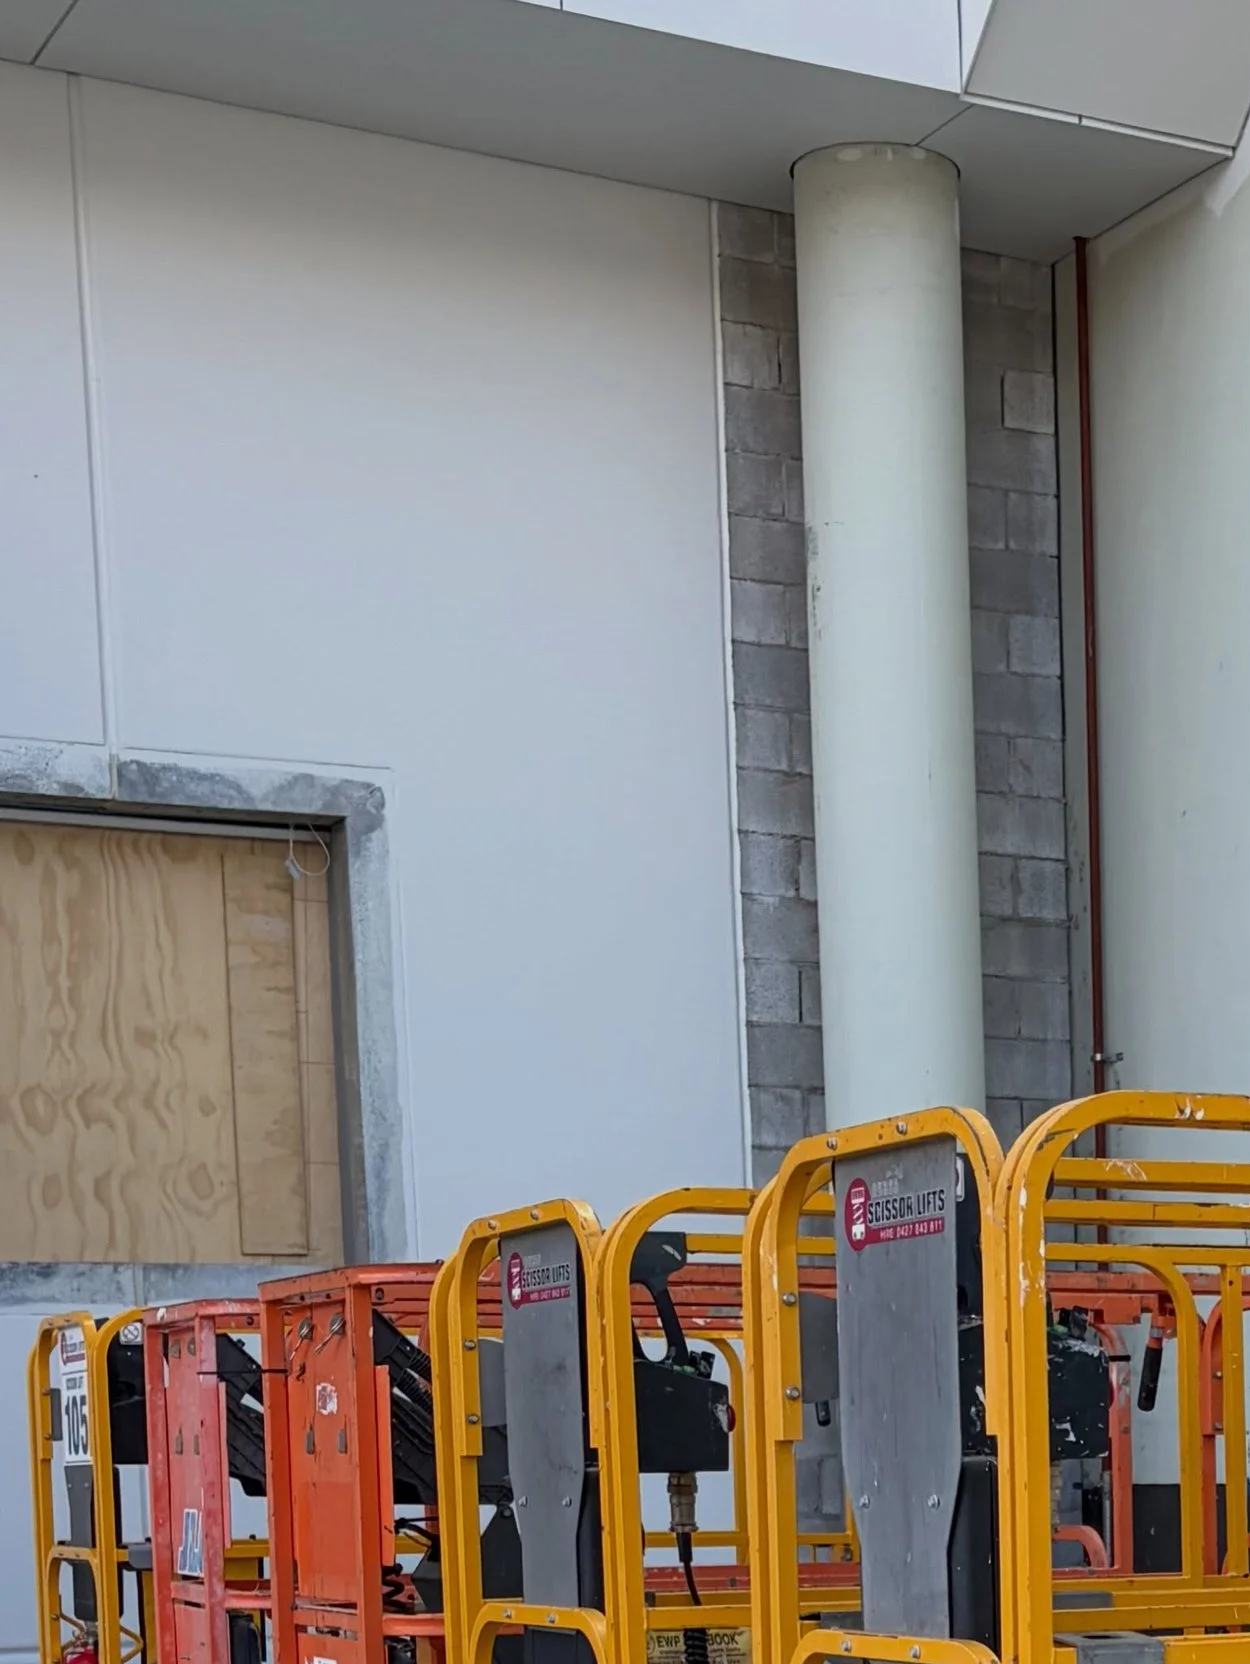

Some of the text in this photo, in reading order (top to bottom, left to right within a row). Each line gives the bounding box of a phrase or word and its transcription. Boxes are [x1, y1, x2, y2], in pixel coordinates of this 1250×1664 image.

[868, 1189, 945, 1224] SCISSOR LIFTS
[522, 1263, 571, 1288] SCISSOR LIFTS
[65, 1395, 88, 1456] 105
[656, 1636, 681, 1648] EWP
